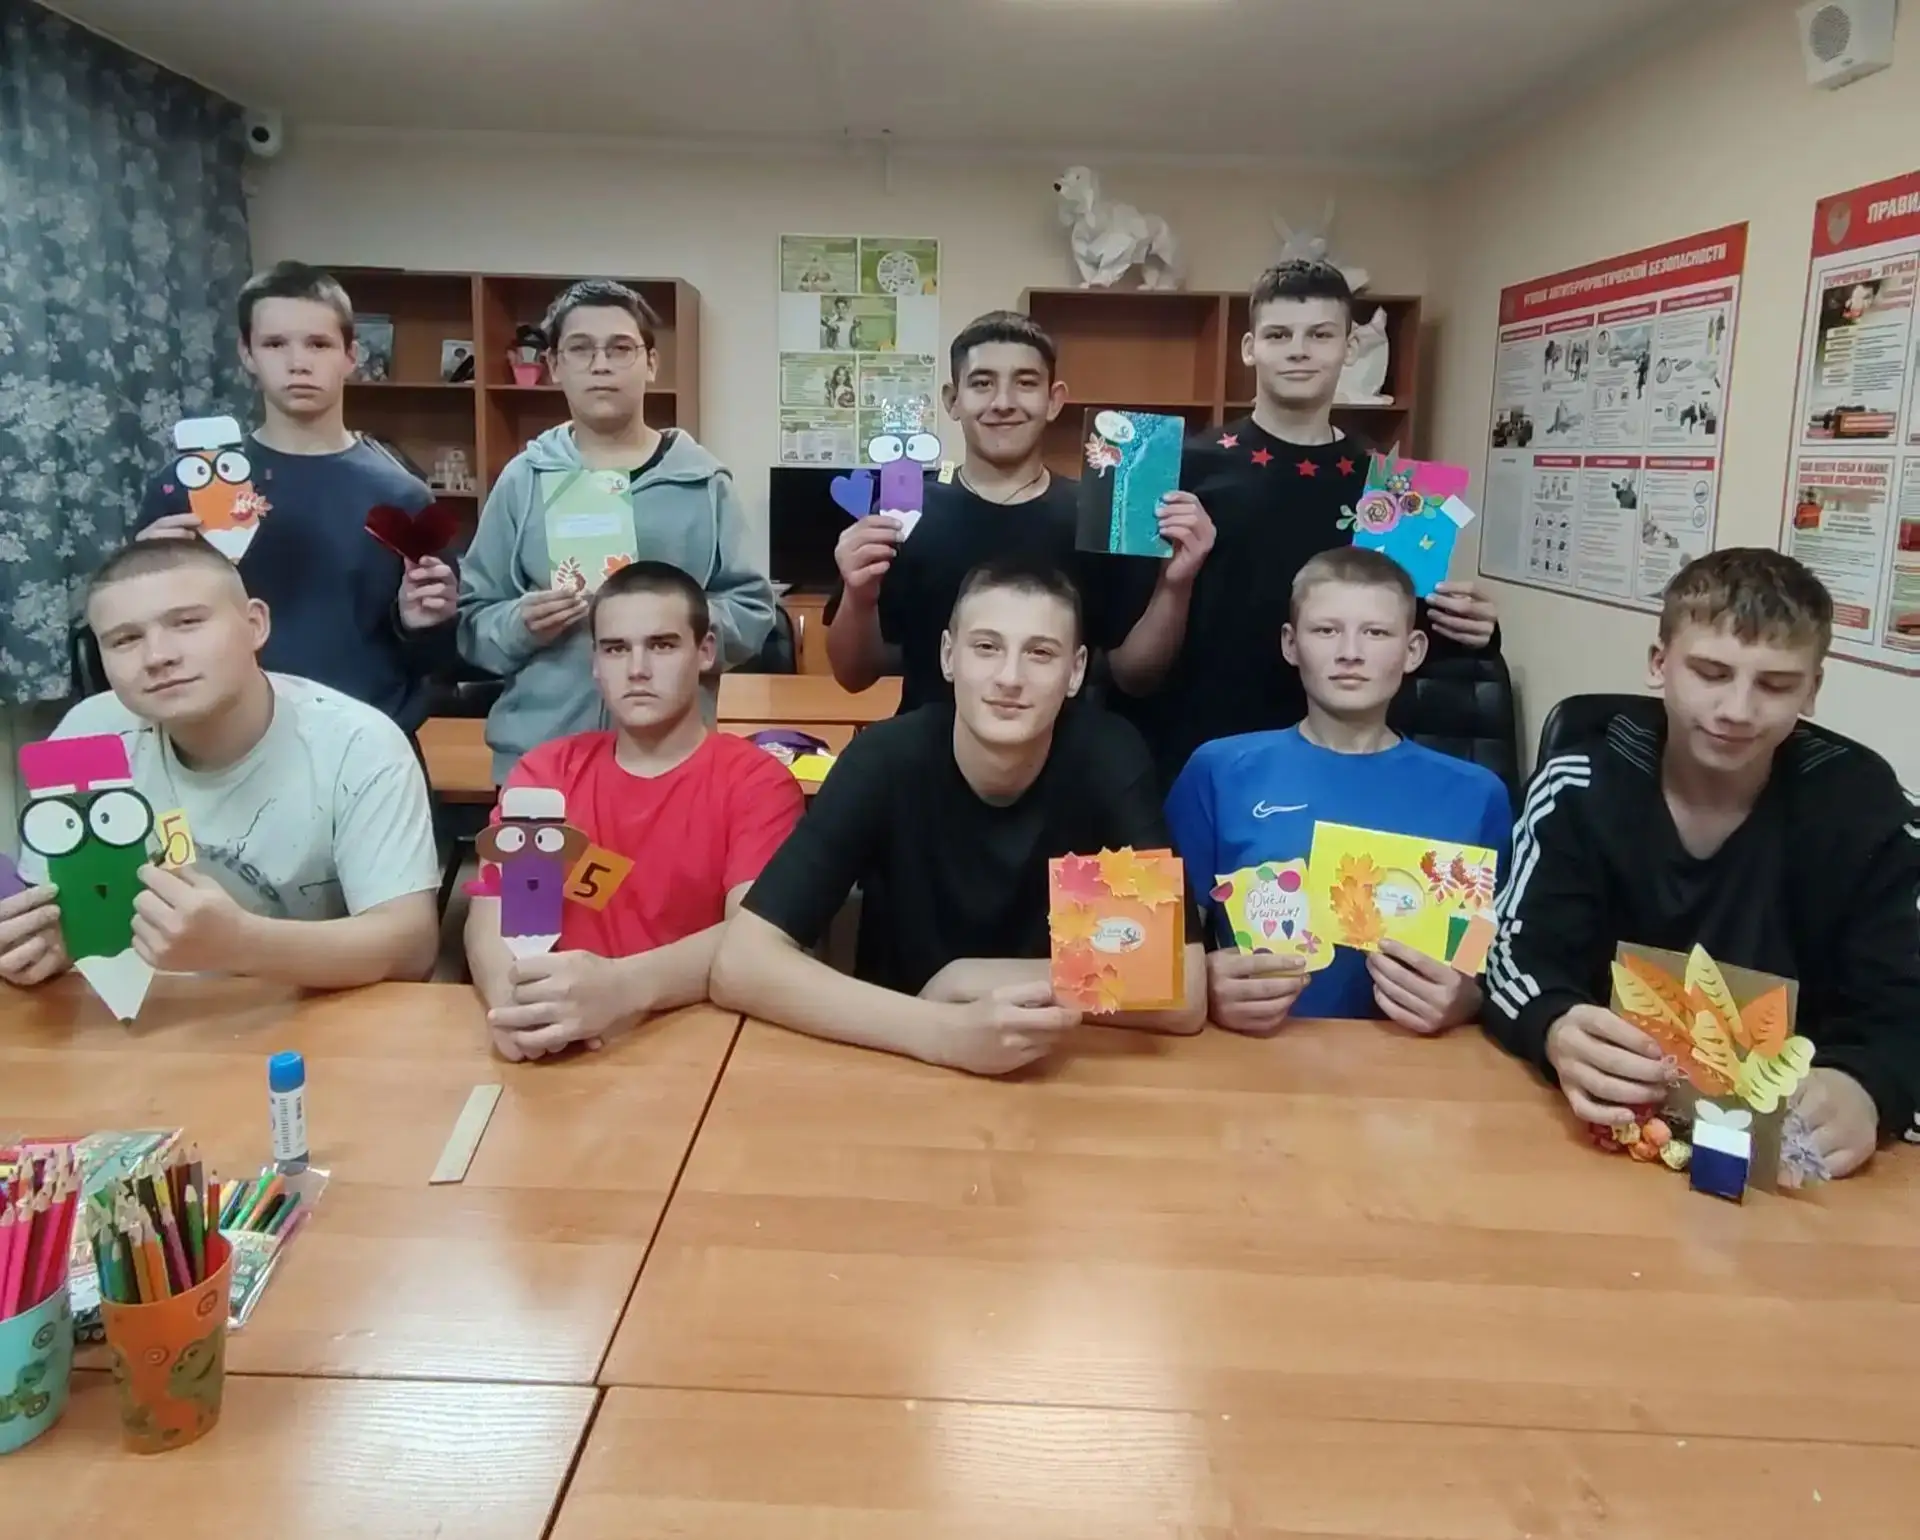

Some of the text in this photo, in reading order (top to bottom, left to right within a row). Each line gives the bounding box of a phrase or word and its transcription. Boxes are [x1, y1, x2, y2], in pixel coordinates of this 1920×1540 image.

[1866, 191, 1920, 223] ПРАВИ
[1648, 243, 1728, 276] БЕЗОПАСНОСТИ
[162, 814, 190, 865] 5
[573, 861, 612, 898] 5
